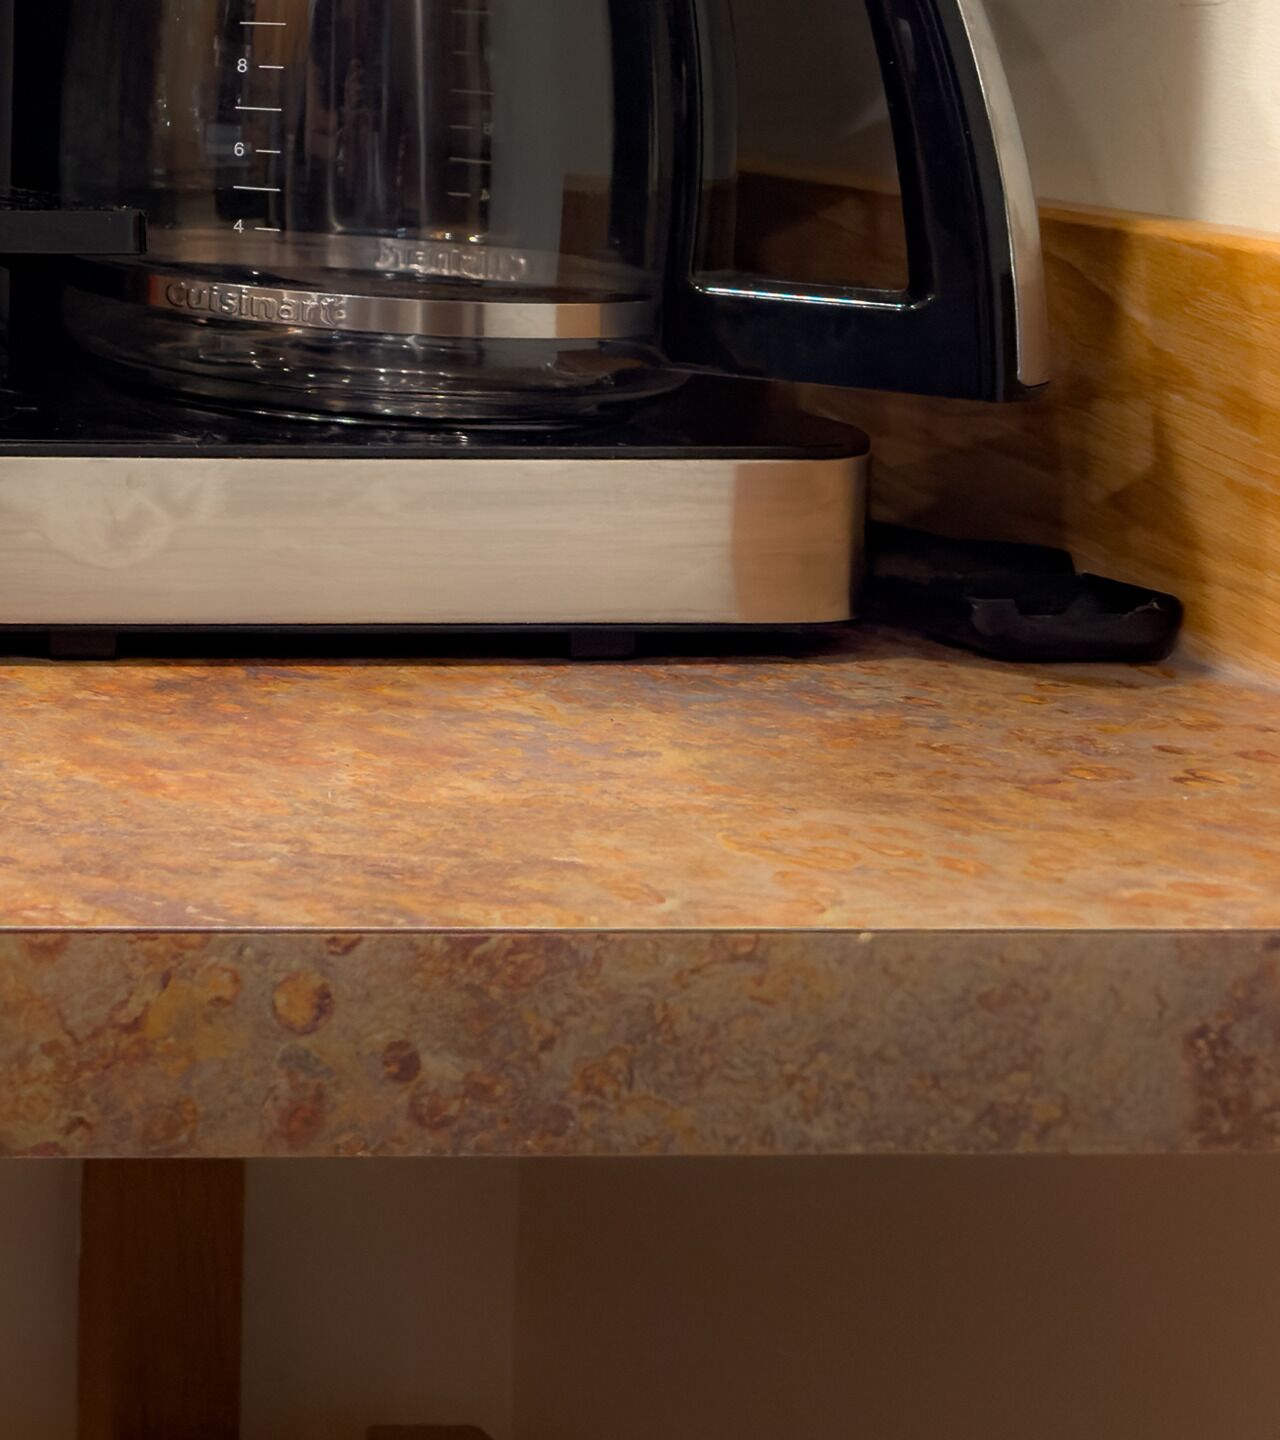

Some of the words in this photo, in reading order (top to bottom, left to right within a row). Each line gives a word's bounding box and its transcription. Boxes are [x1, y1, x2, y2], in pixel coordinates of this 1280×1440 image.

[236, 58, 248, 74] 8
[233, 141, 245, 157] 6
[233, 218, 245, 234] 4
[165, 280, 340, 326] Cuisinart
